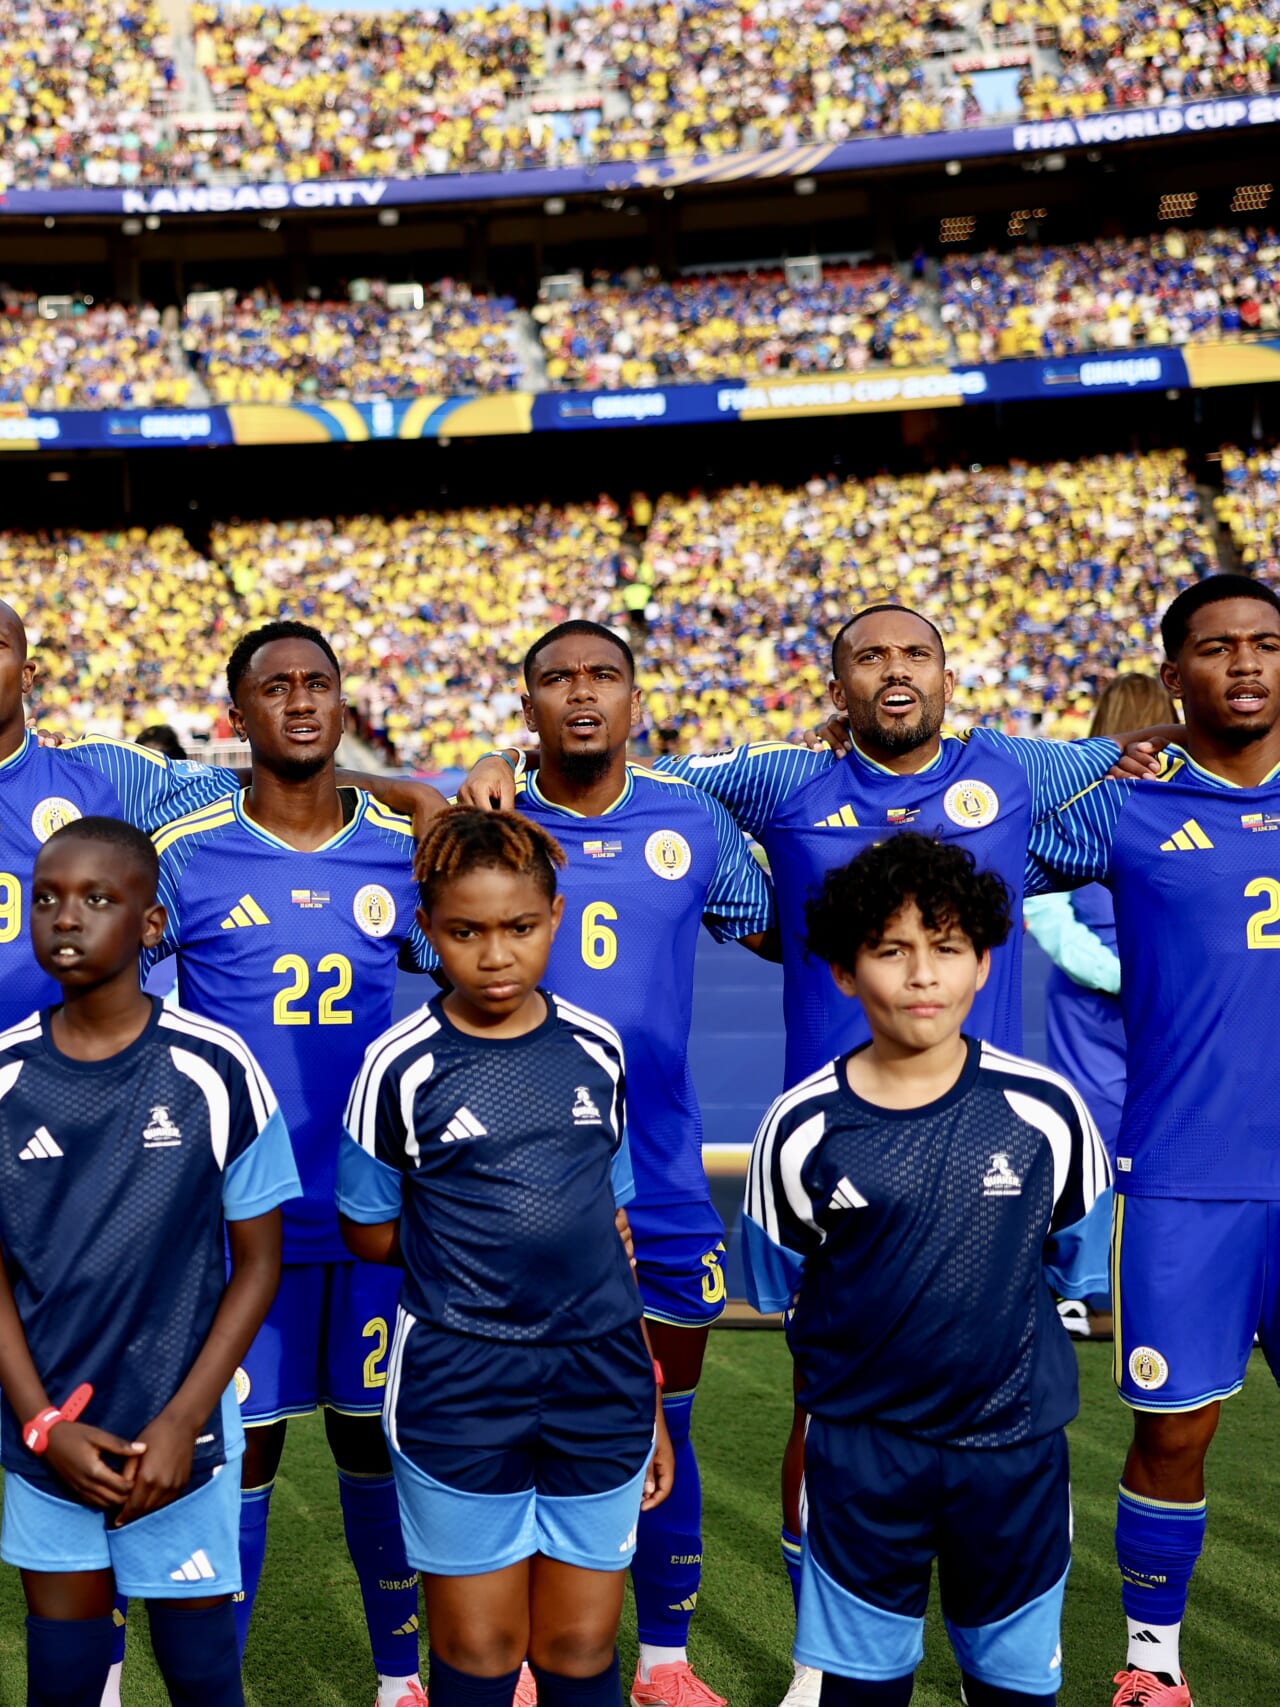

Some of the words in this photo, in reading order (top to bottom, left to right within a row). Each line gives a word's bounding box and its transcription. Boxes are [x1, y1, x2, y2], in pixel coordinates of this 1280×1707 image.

[1012, 121, 1076, 150] FIFA
[1075, 109, 1183, 143] WORLD
[1185, 101, 1247, 130] CUP
[122, 184, 290, 213] KANSAS
[292, 180, 387, 208] CITY
[717, 387, 768, 412] FIFA
[768, 381, 852, 408] WORLD
[852, 378, 900, 403] CUP
[582, 901, 618, 969] 6
[273, 953, 353, 1025] 22
